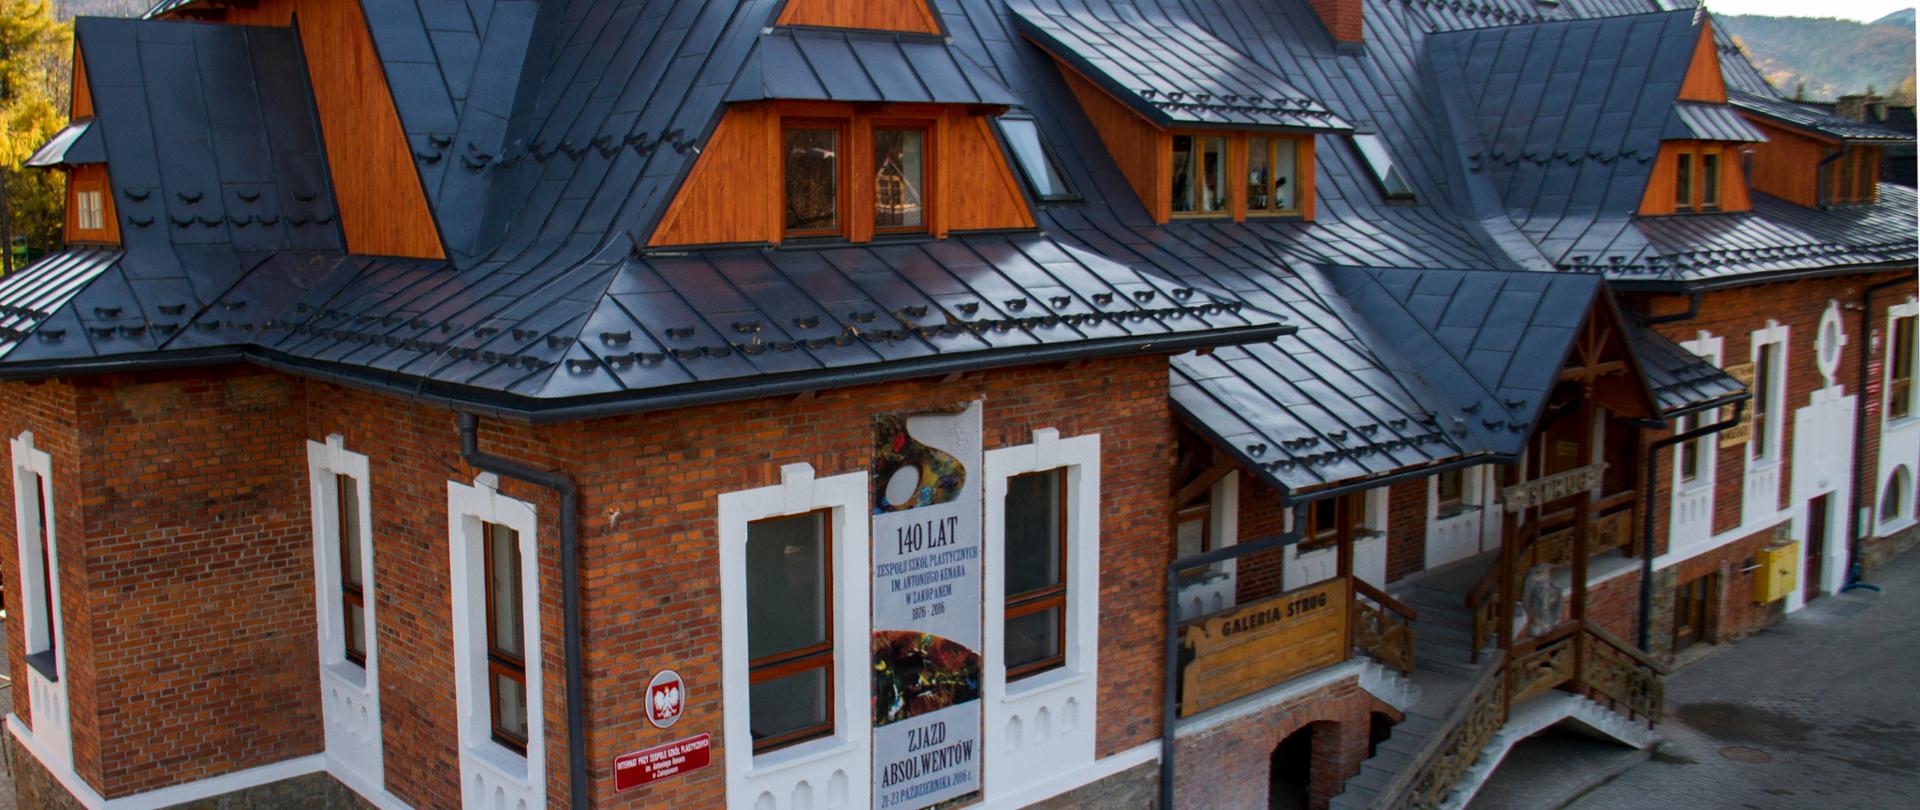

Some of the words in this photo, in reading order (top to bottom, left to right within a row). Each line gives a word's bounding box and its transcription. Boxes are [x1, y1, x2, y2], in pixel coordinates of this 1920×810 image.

[897, 523, 923, 555] 140
[927, 516, 958, 549] LAT
[929, 545, 978, 568] PLASTYCZNYCH
[903, 570, 939, 590] ANTONIEGO
[940, 565, 966, 582] KENARA
[905, 592, 911, 605] W
[912, 583, 952, 604] ZAKOPANEM
[912, 605, 926, 620] 1876
[931, 601, 945, 617] 2016
[1222, 607, 1280, 637] GALERIA
[1287, 592, 1327, 618] STRUG
[908, 721, 946, 753] ZJAZD
[617, 758, 637, 770] INTERNAT
[882, 739, 973, 789] ABSOLWENTÓW
[881, 791, 899, 809] 21-23
[952, 769, 968, 786] 2016
